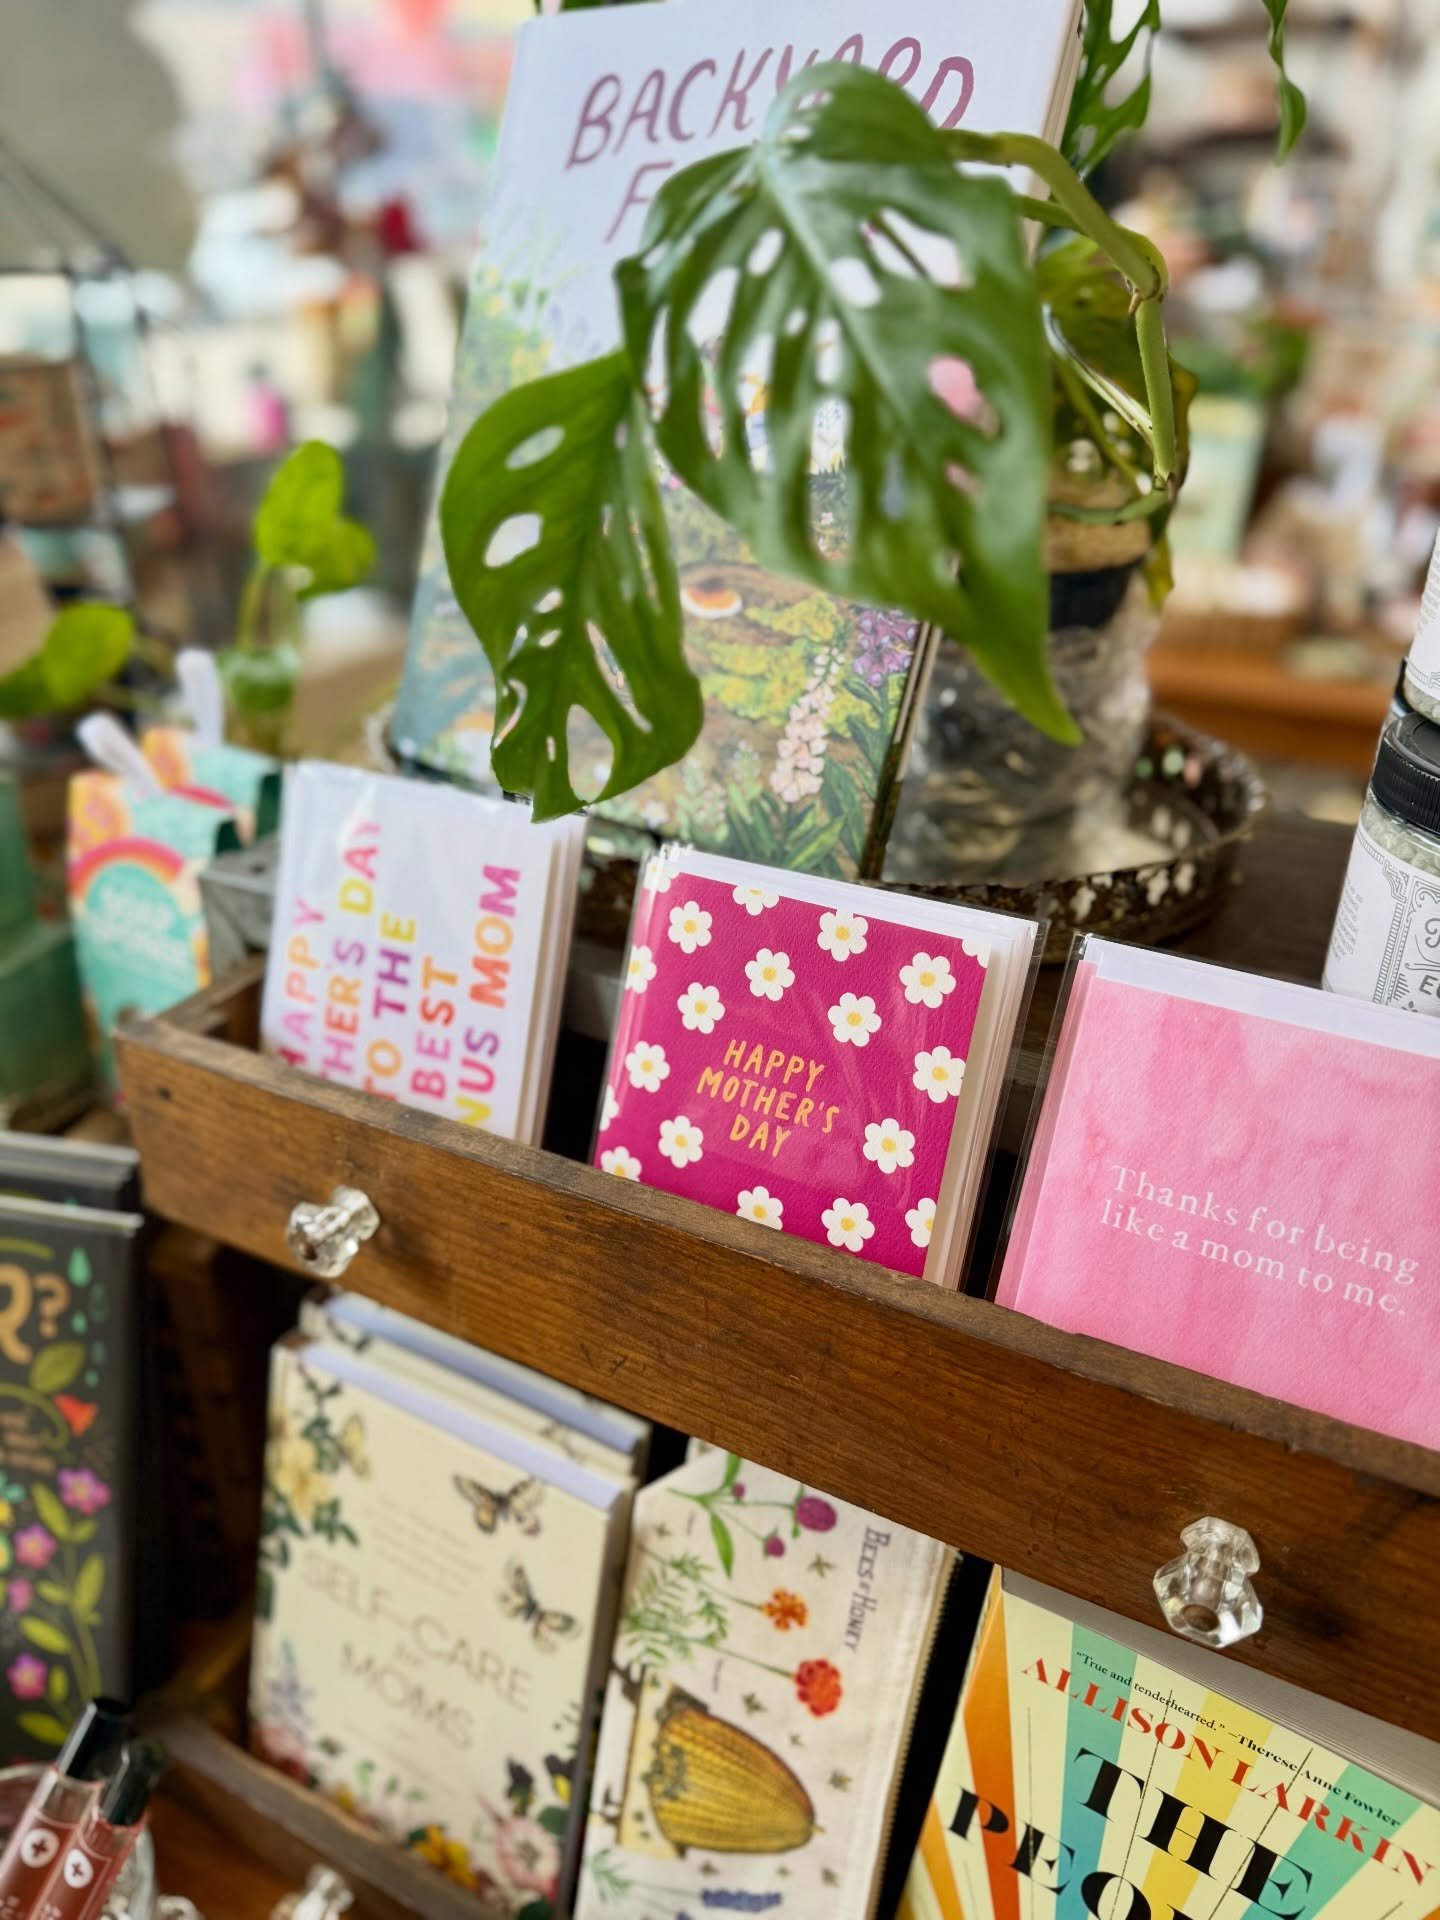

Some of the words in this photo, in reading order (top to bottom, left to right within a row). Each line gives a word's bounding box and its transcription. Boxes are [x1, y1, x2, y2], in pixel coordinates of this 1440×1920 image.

[338, 819, 381, 917] DAY
[372, 912, 417, 1020] THE
[469, 864, 521, 1009] MOM
[409, 955, 458, 1101] BEST
[723, 1039, 825, 1093] HAPPY
[695, 1066, 840, 1134] MOTHER'S
[729, 1113, 792, 1158] DAY
[1100, 1199, 1165, 1241] like
[1172, 1230, 1190, 1250] a
[1199, 1238, 1285, 1280] mom
[1298, 1266, 1334, 1293] to
[1342, 1281, 1406, 1316] me.
[1111, 1164, 1239, 1226] Thanks
[1247, 1206, 1305, 1245] for
[1314, 1223, 1419, 1285] being
[301, 1549, 534, 1712] SELF-CARE
[340, 1640, 475, 1749] MOMS
[1109, 1668, 1133, 1687] and
[1299, 1769, 1343, 1796] Anne
[1343, 1790, 1402, 1828] Fowler
[1021, 1657, 1224, 1771] ALLISON
[1228, 1758, 1437, 1887] LARKIN
[947, 1785, 1195, 1920] PEO
[1073, 1747, 1313, 1920] THE
